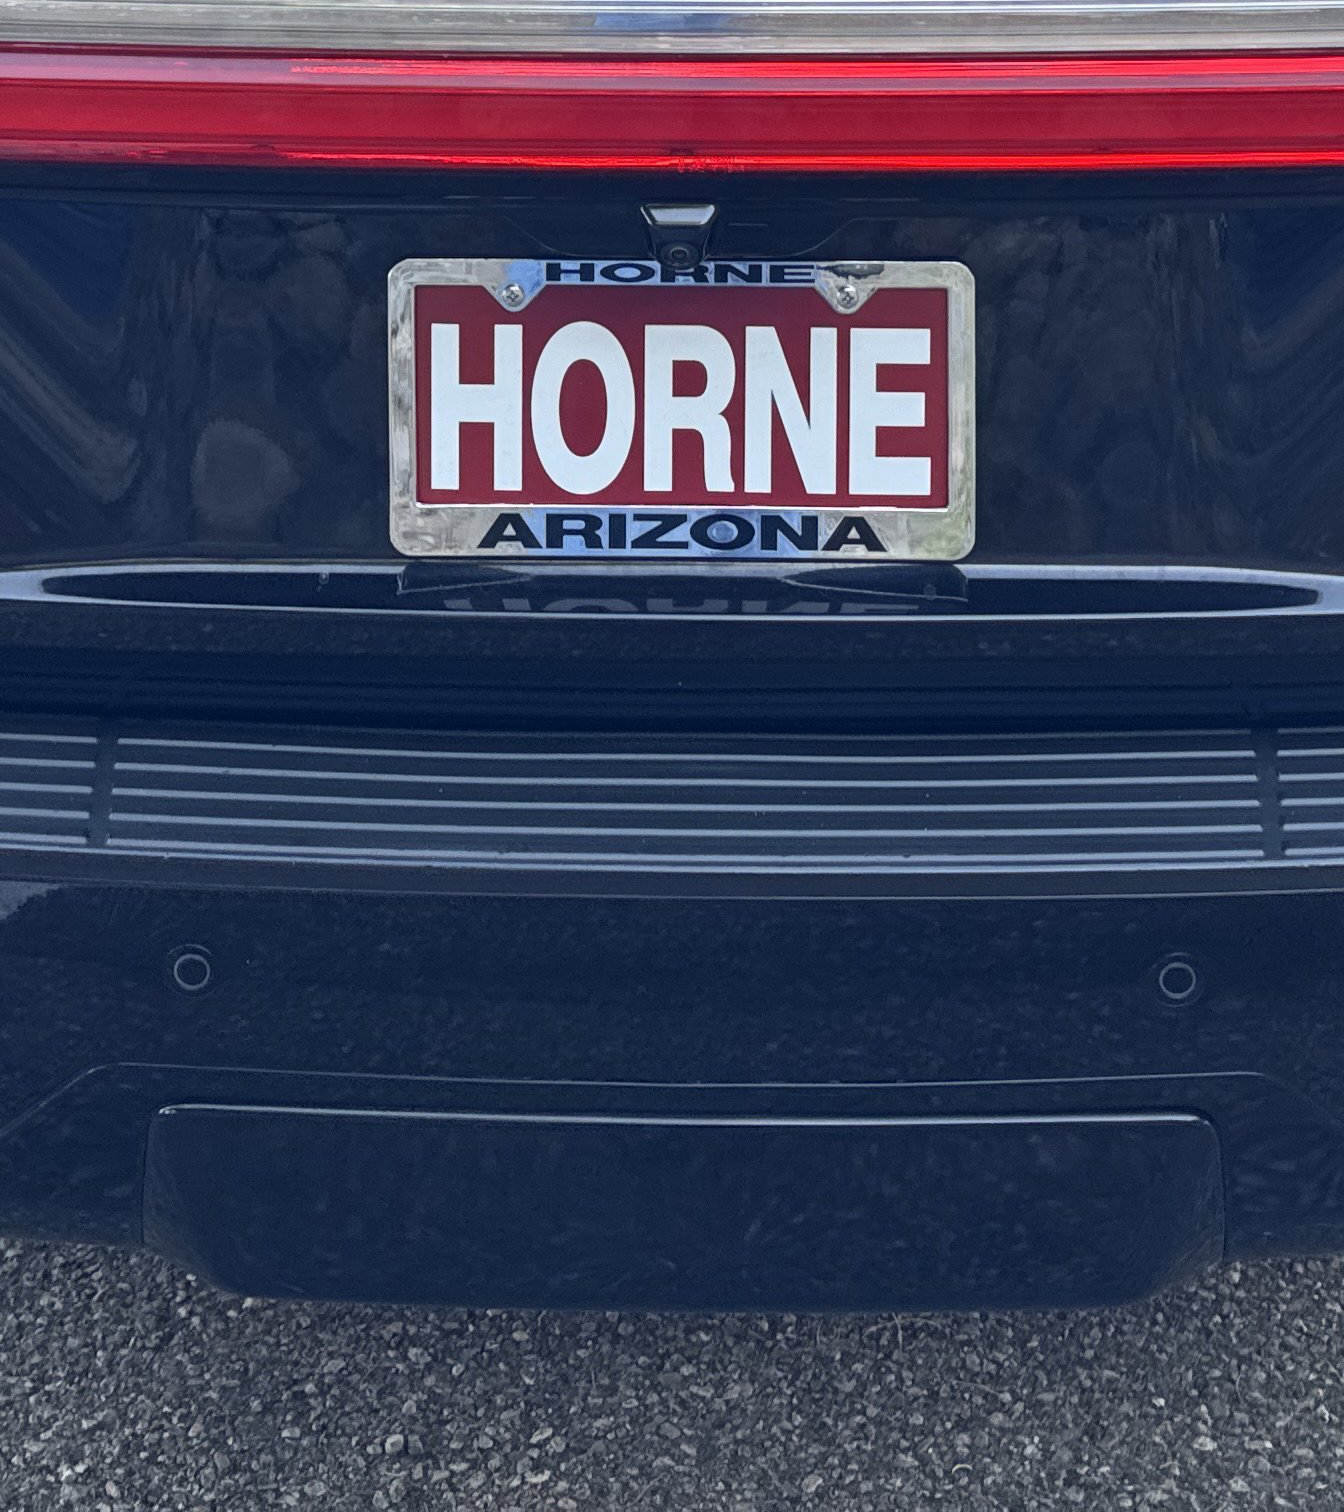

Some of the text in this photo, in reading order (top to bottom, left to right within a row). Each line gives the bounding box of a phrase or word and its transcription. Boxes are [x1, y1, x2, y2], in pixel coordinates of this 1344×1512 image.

[545, 262, 816, 284] HORNE
[429, 320, 932, 496] HORNE
[476, 512, 889, 553] ARIZONA
